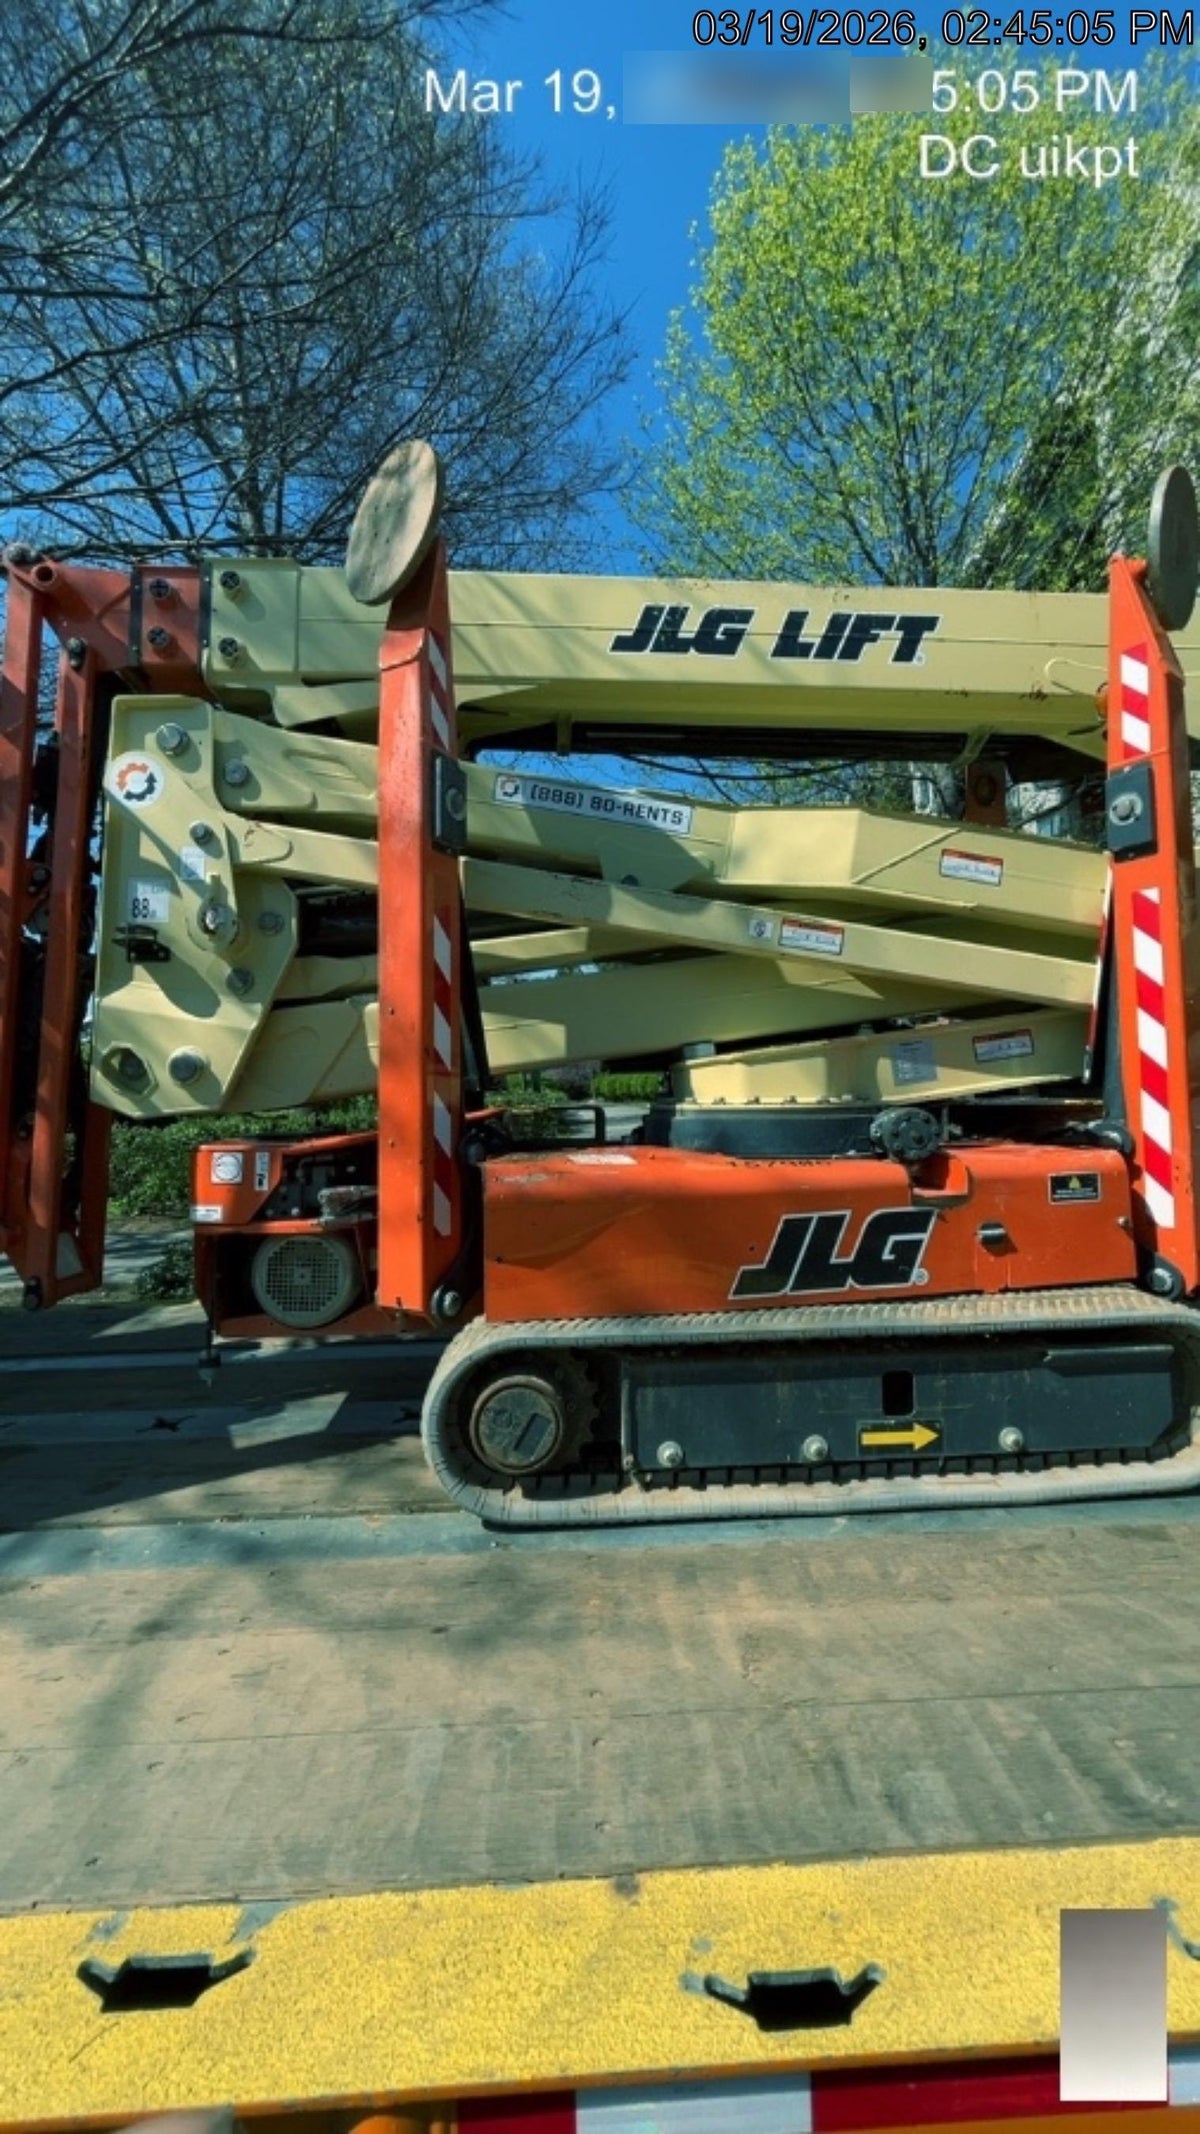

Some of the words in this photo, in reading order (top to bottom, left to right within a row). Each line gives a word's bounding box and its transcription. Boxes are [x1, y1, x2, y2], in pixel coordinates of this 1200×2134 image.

[608, 604, 756, 656] JLG
[769, 609, 941, 663] LIFT
[530, 784, 584, 810] (888)
[728, 1207, 938, 1299] JLG
